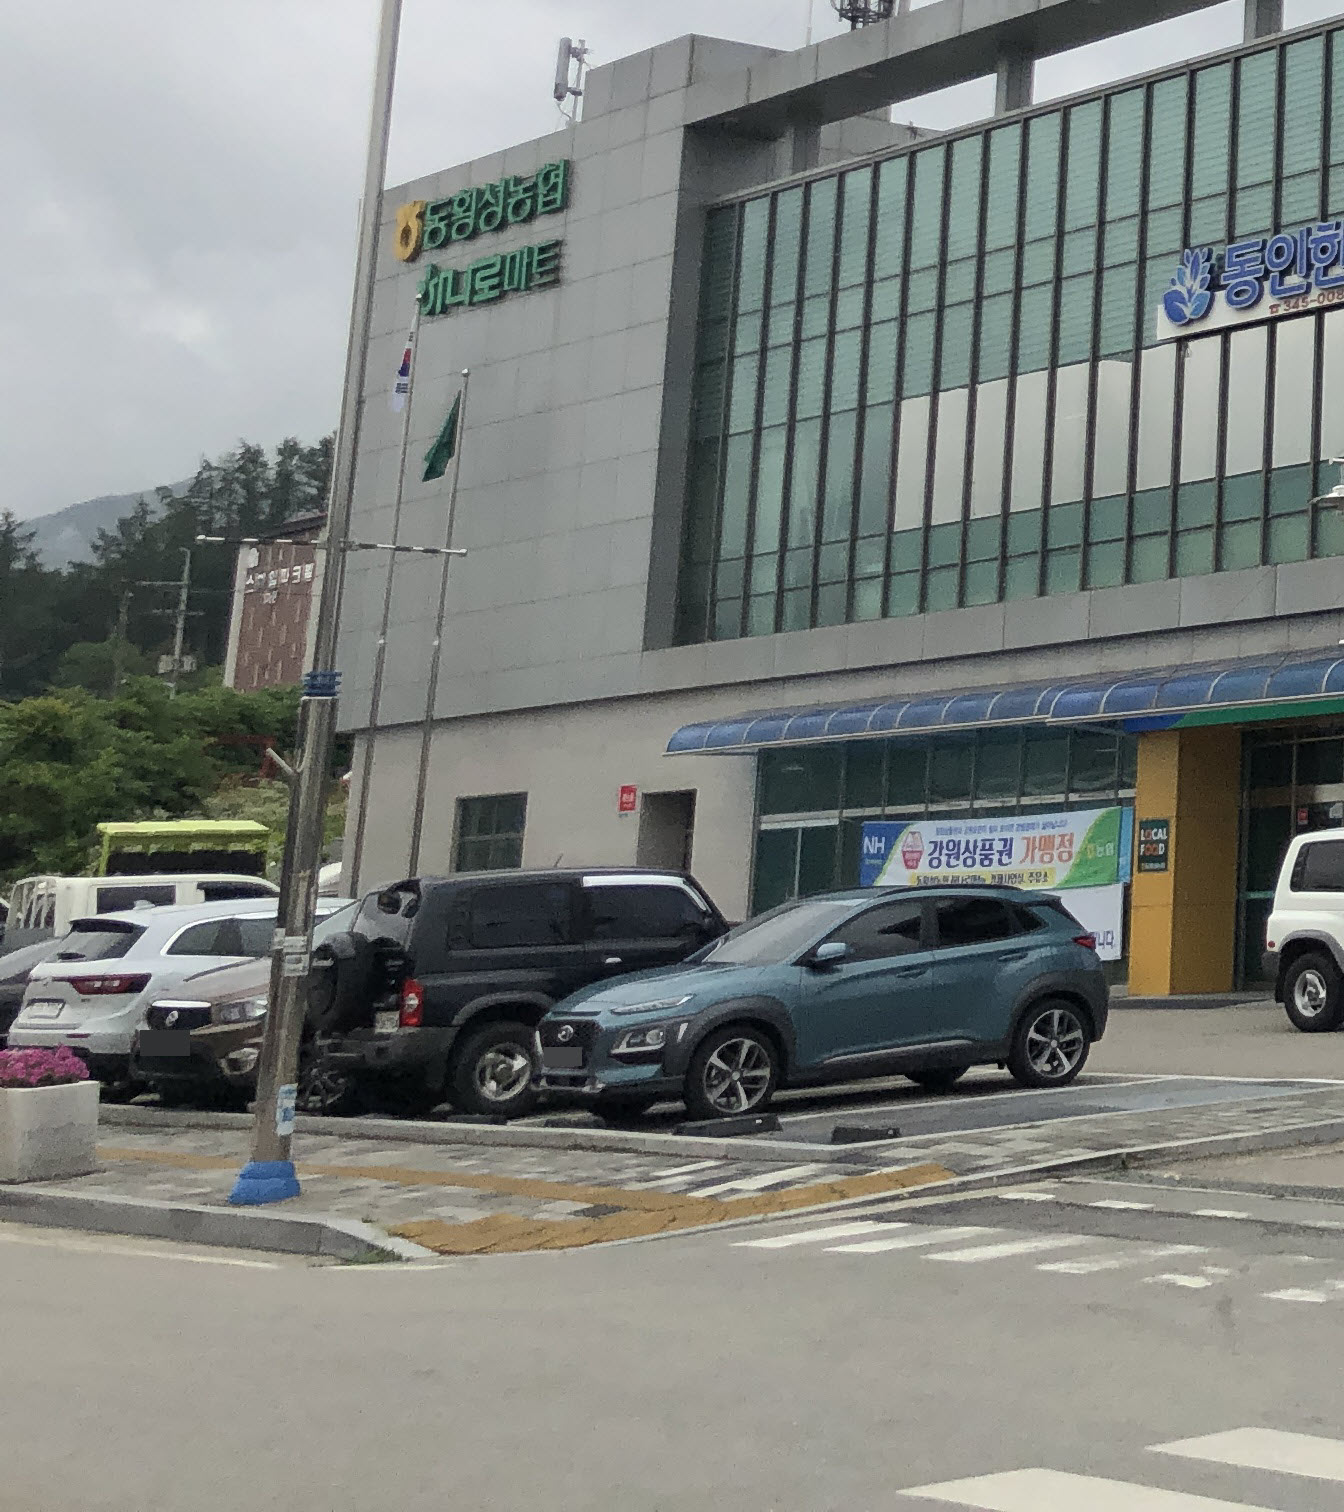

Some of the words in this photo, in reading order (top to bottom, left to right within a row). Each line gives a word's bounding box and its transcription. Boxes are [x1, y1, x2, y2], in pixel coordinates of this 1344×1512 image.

[423, 159, 571, 251] 동횡성농협
[416, 239, 562, 316] 하나로마트
[863, 835, 886, 855] NH
[1140, 827, 1168, 841] LOCAL
[927, 836, 1015, 870] 강원상품권
[1140, 842, 1165, 856] FOOD
